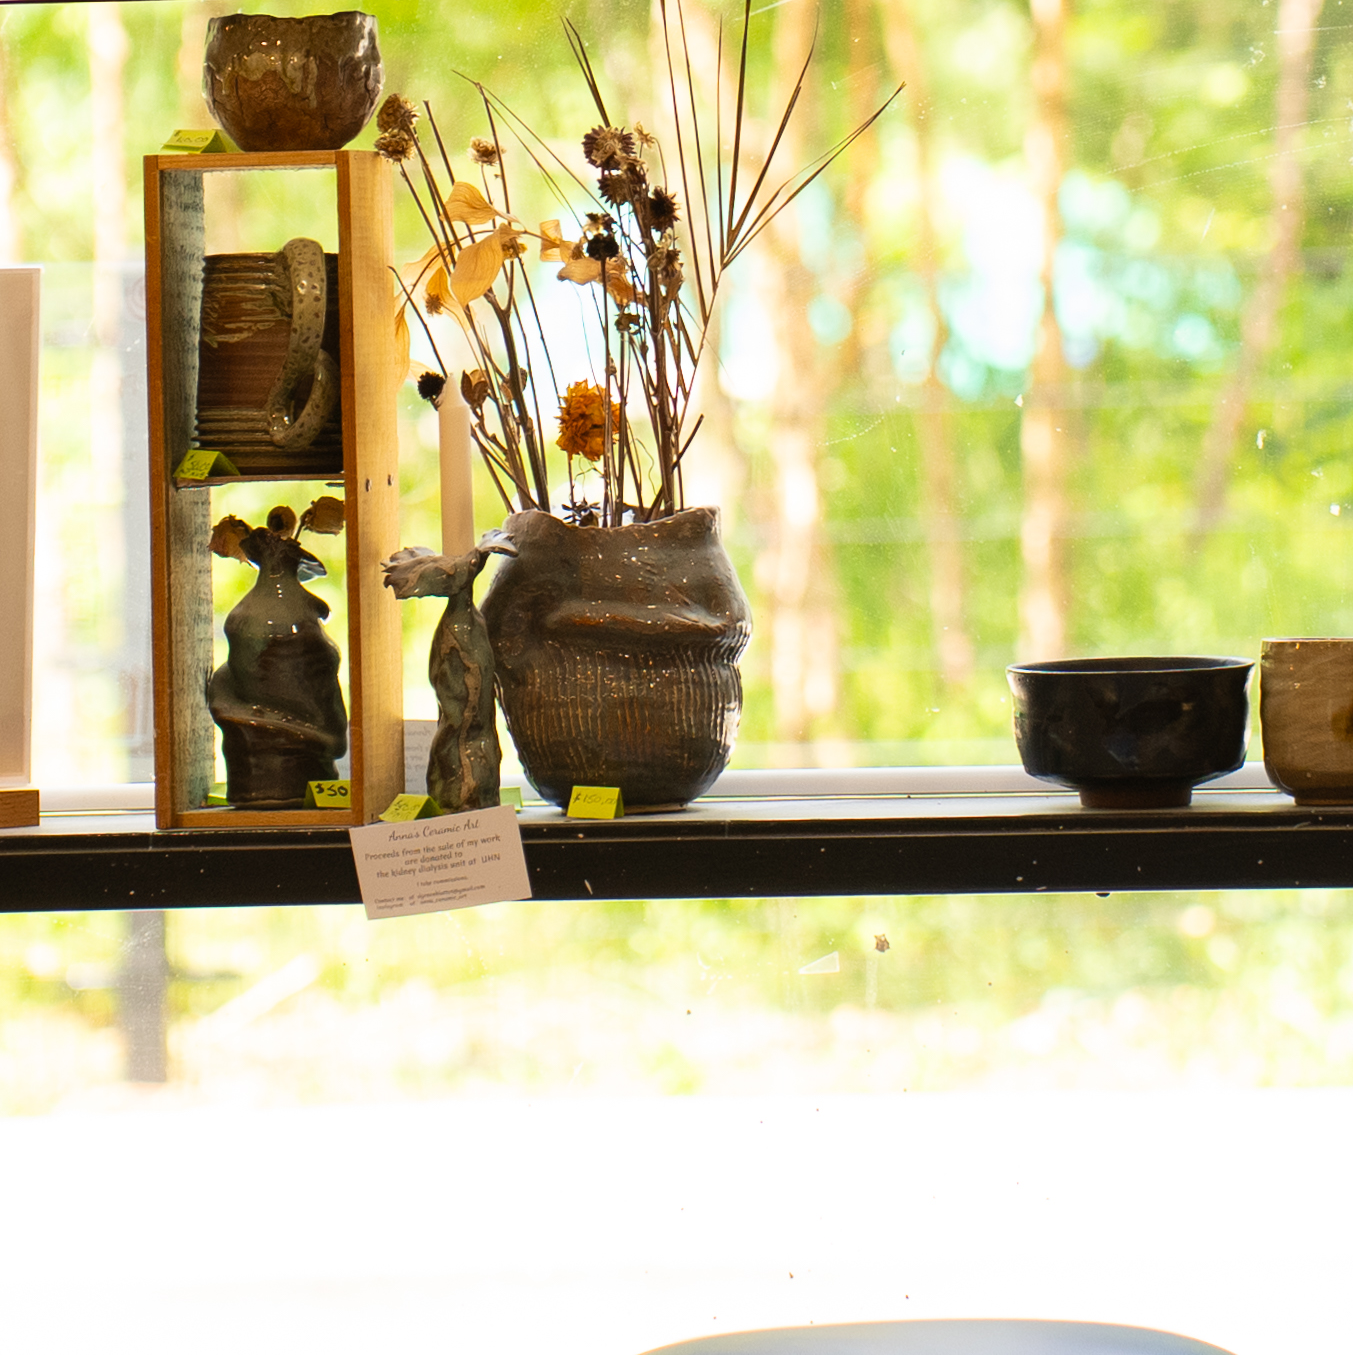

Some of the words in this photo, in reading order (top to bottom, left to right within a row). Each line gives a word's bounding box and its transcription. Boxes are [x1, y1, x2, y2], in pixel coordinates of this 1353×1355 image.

[315, 782, 349, 797] $50
[389, 827, 420, 842] Anna's
[422, 824, 462, 838] Ceramic
[463, 819, 480, 832] Art
[364, 849, 400, 861] Proceeds
[402, 848, 421, 857] from
[423, 845, 436, 854] the
[438, 842, 454, 852] sale
[456, 839, 466, 849] of
[467, 839, 479, 848] my
[480, 834, 501, 844] work
[404, 858, 418, 866] are
[420, 850, 452, 864] donated
[454, 851, 463, 859] to
[376, 869, 390, 879] the
[391, 866, 417, 878] kidney
[418, 862, 448, 874] dialysis
[468, 857, 477, 866] at
[481, 852, 501, 864] UHN
